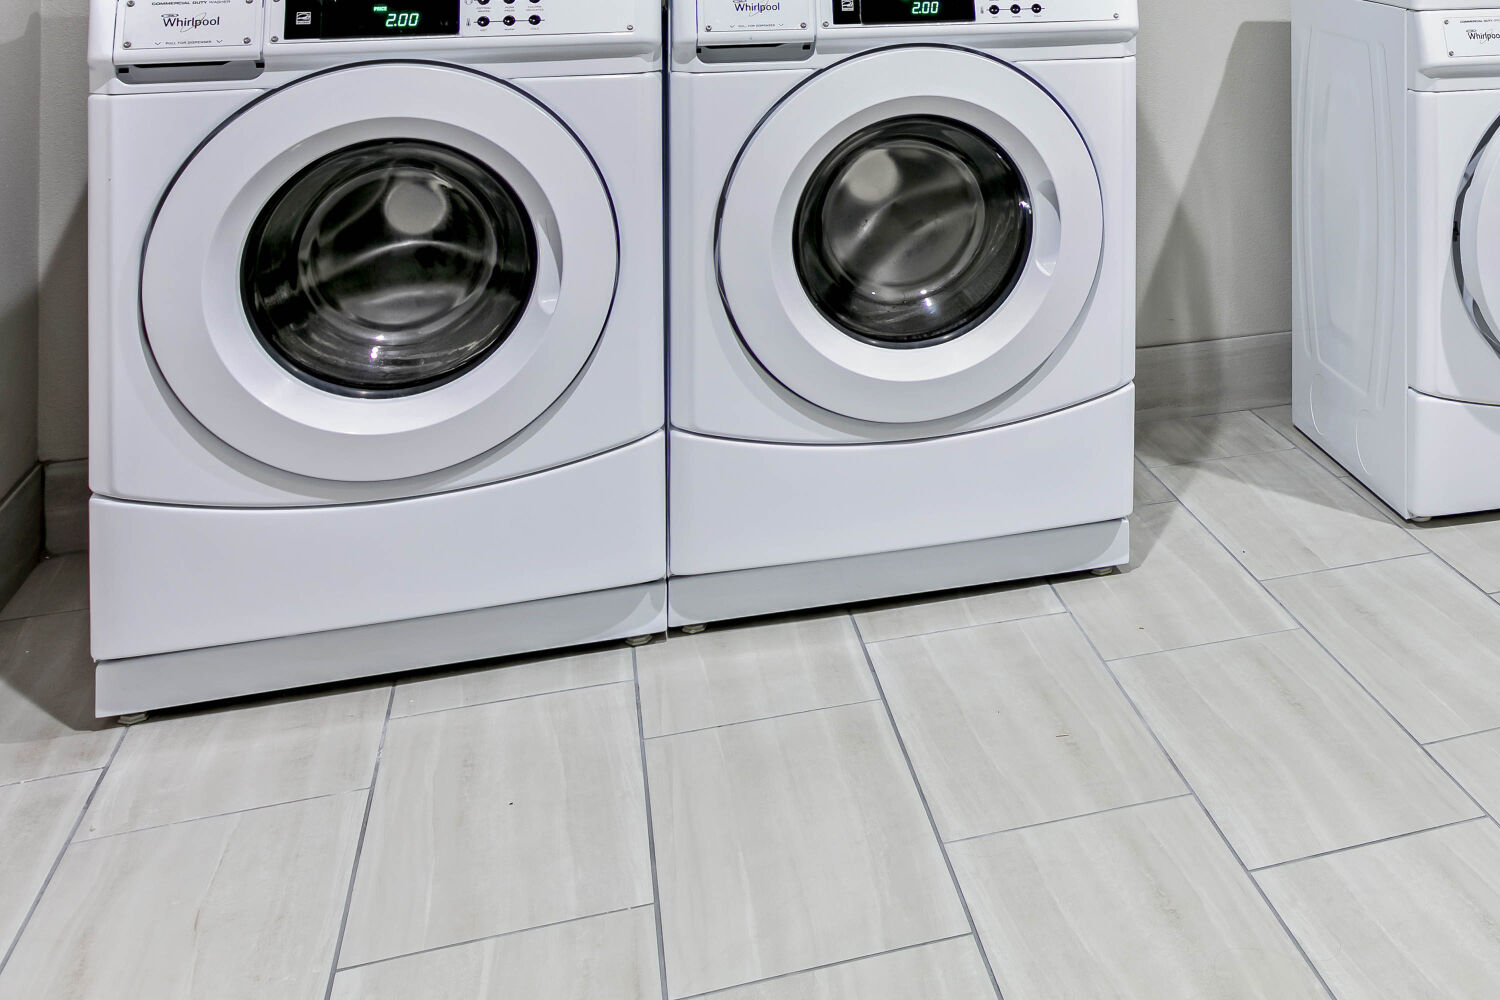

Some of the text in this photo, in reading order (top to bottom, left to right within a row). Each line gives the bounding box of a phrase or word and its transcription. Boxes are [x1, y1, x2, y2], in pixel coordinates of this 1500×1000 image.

[734, 2, 780, 13] Whirlpool
[912, 1, 939, 14] 2.00
[162, 16, 220, 29] Whirlpool
[385, 12, 419, 27] 2.00
